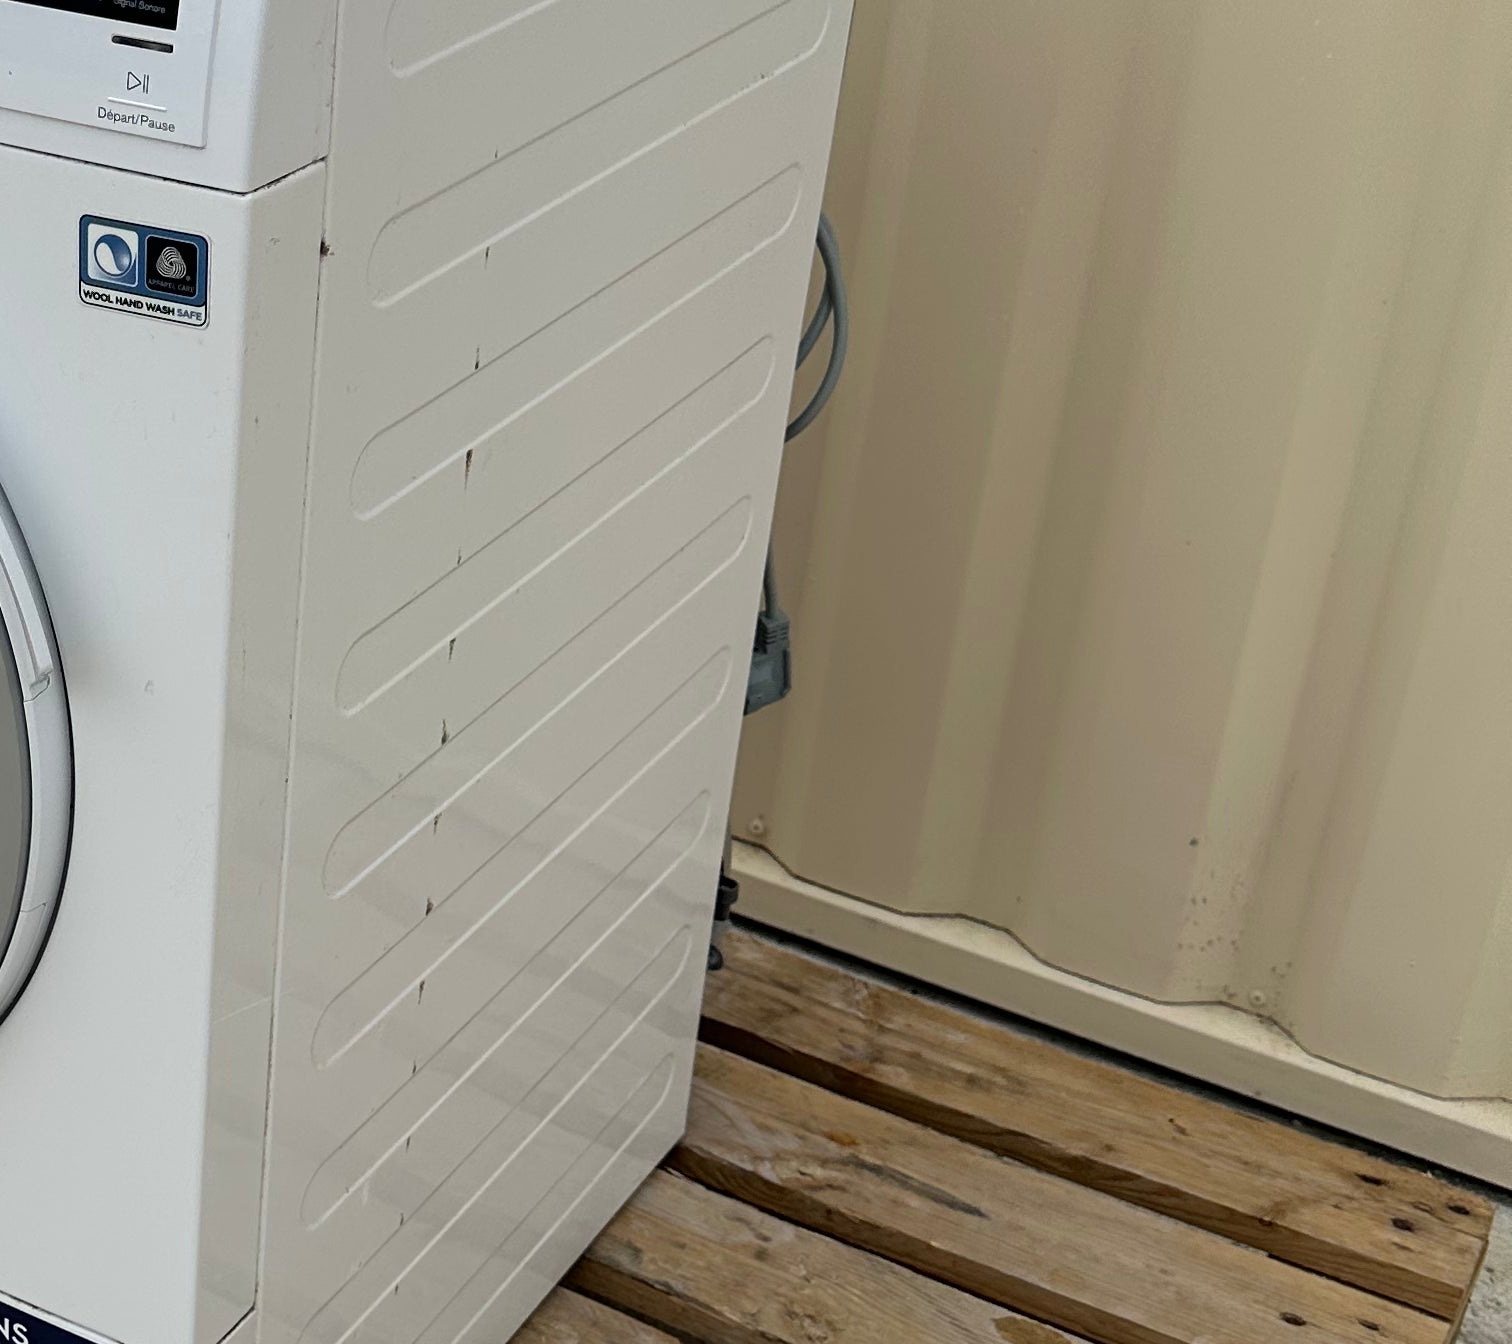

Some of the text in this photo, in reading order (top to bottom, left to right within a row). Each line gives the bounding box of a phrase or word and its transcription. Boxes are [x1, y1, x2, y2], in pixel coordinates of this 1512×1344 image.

[97, 106, 176, 133] Départ/Pause
[82, 289, 202, 321] WOOL HAND WASH SAFE
